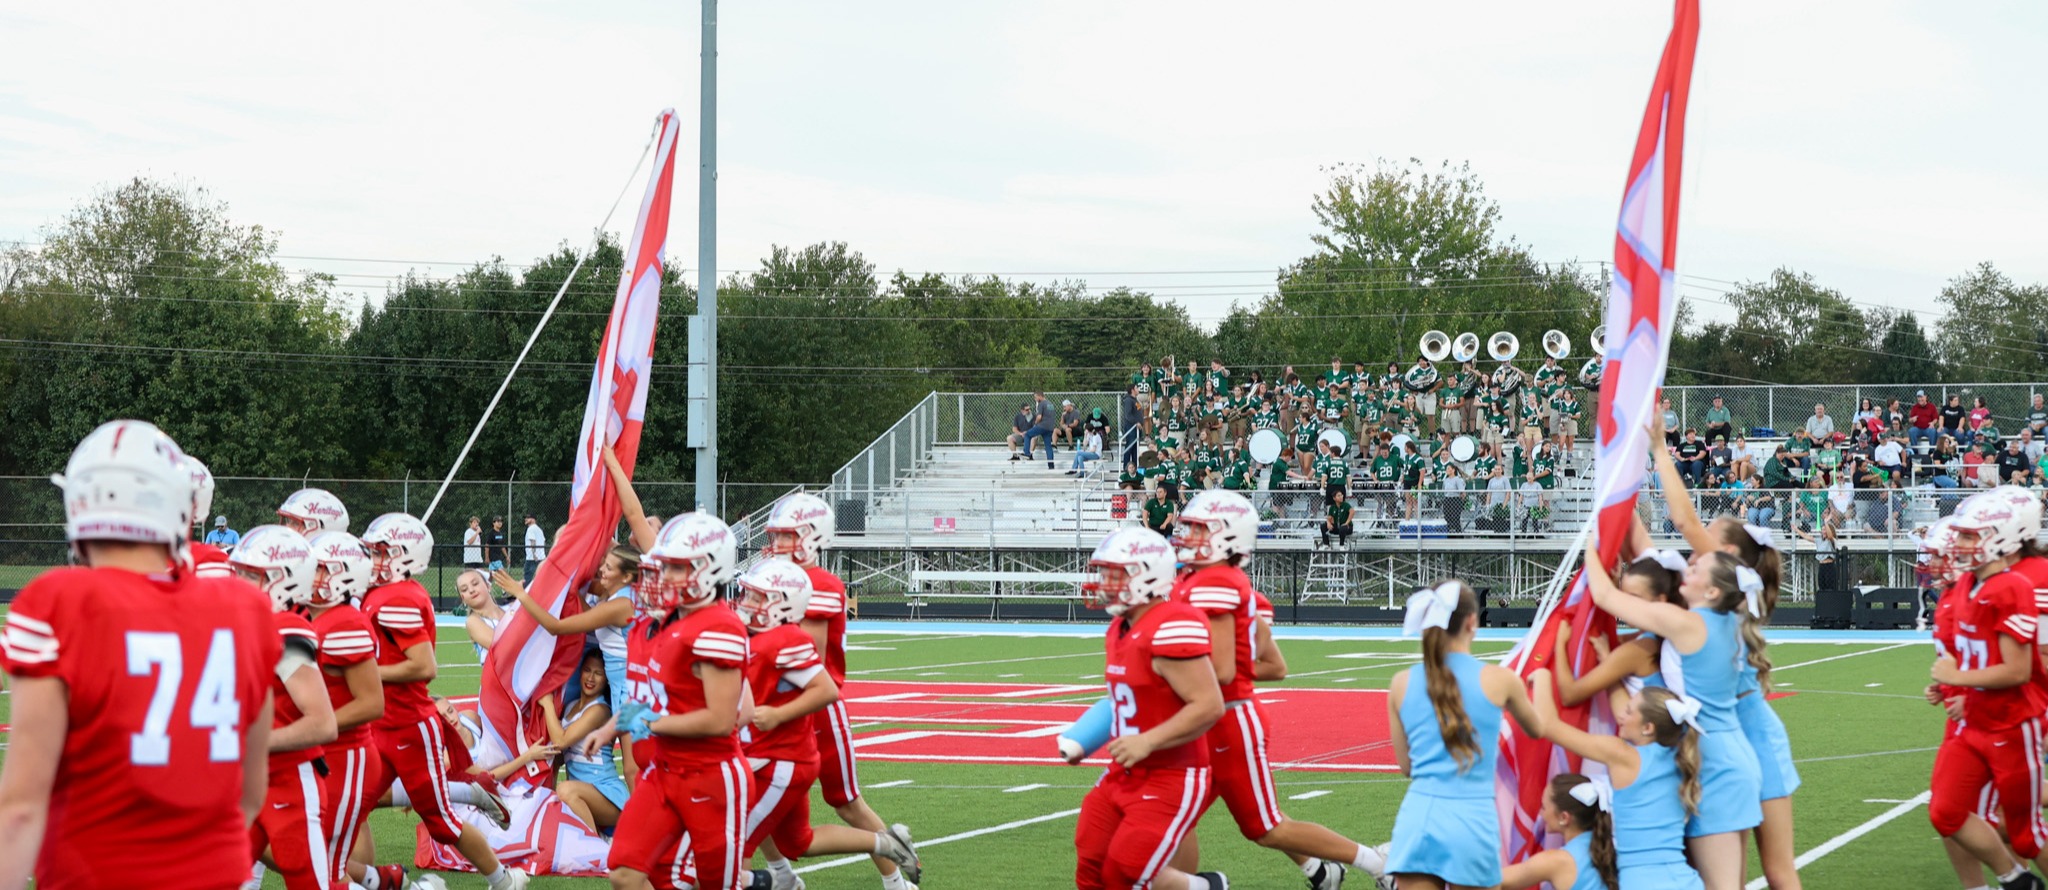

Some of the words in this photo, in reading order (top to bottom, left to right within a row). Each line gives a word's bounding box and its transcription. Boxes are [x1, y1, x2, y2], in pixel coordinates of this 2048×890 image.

[1137, 383, 1150, 393] 28
[1299, 433, 1310, 444] 27
[1198, 452, 1210, 462] 26
[1180, 470, 1192, 480] 27
[1330, 466, 1343, 478] 26
[1379, 466, 1393, 477] 28
[1477, 467, 1489, 477] 26
[125, 627, 241, 767] 74
